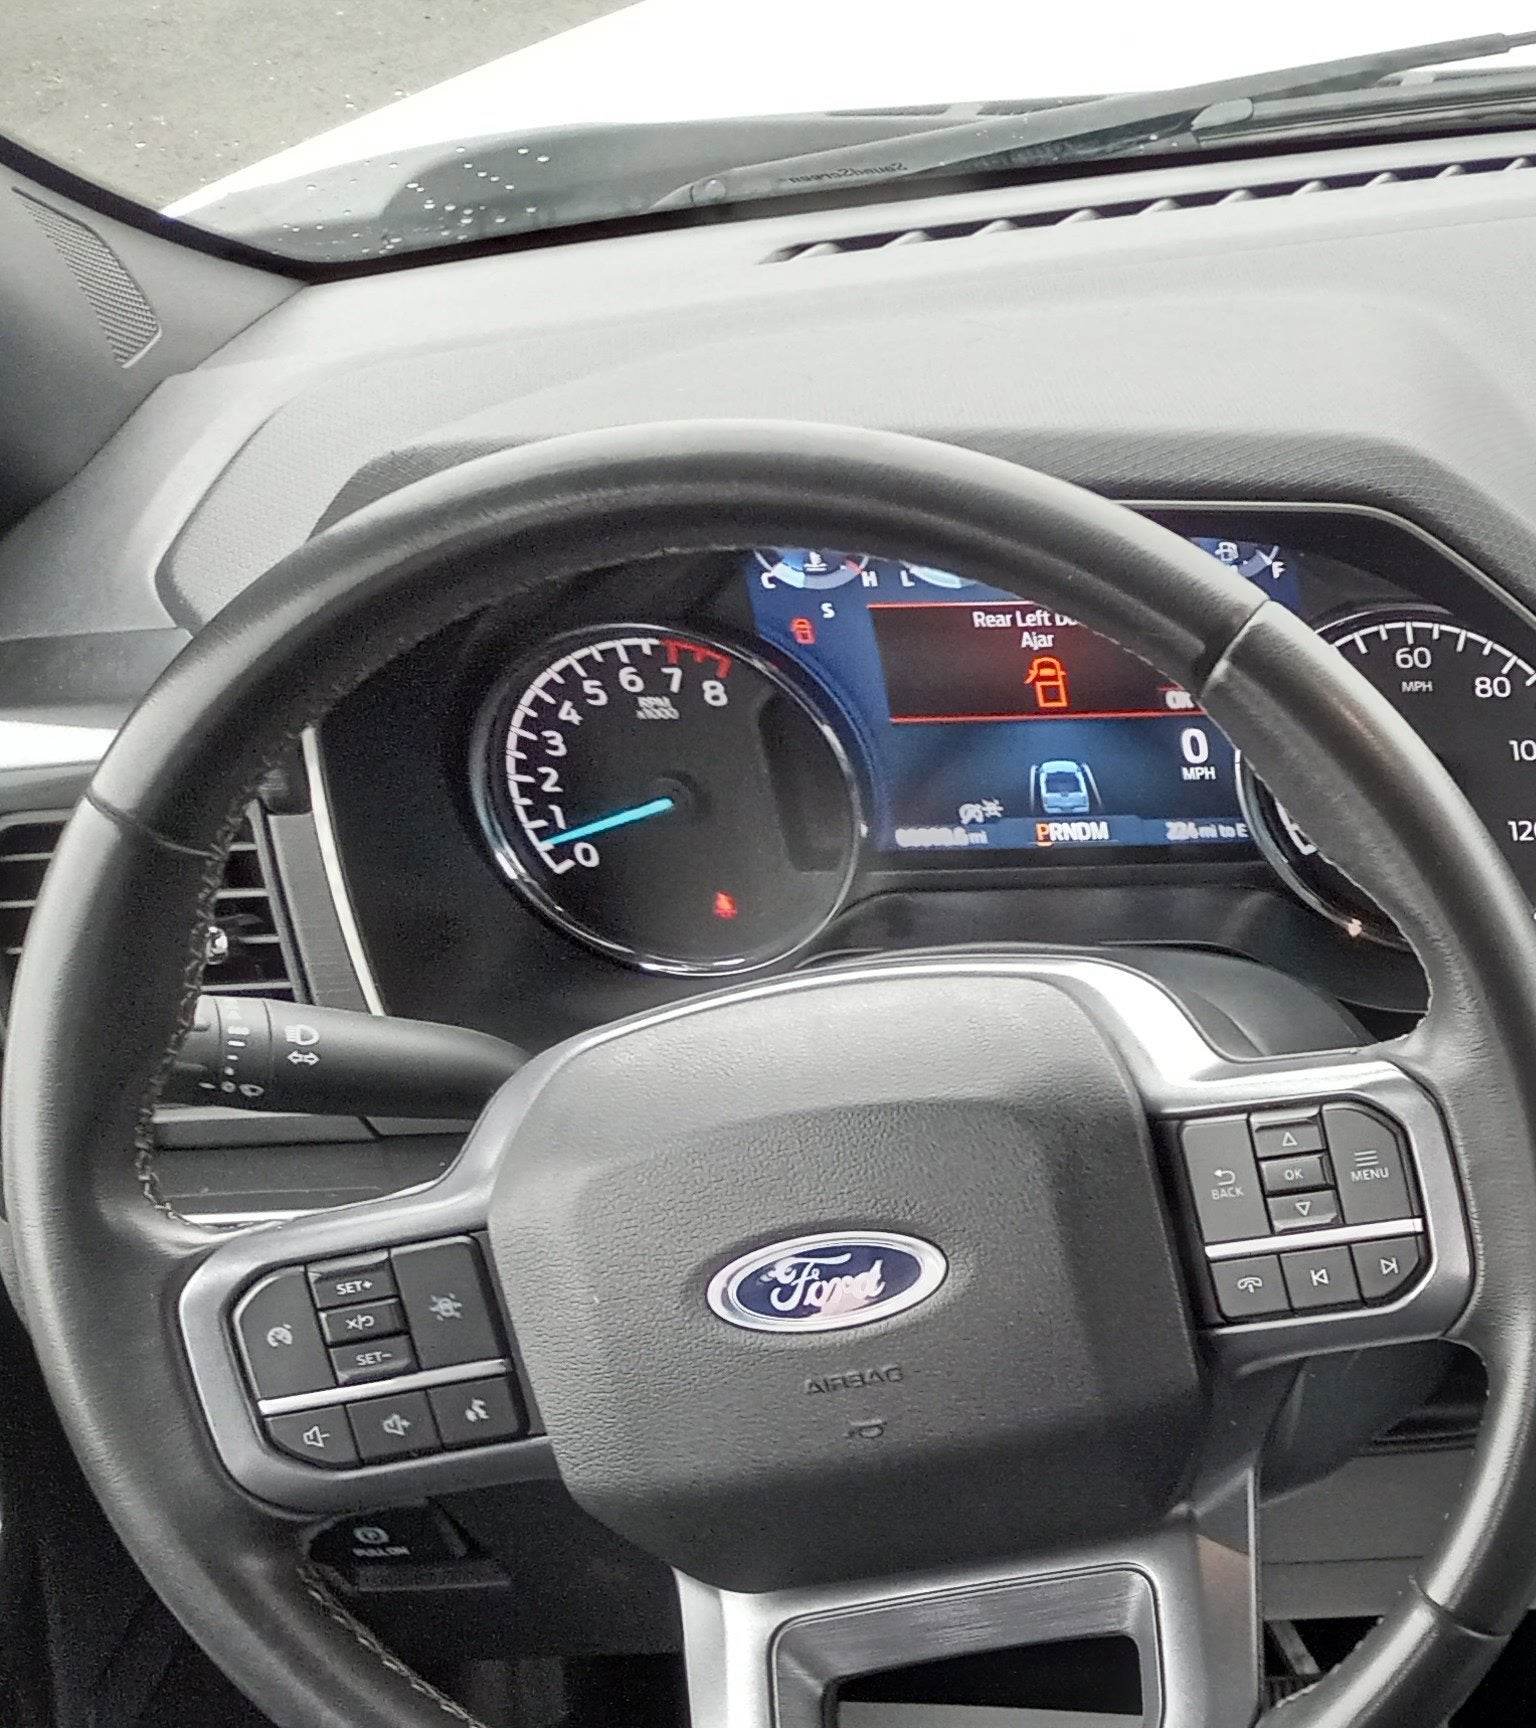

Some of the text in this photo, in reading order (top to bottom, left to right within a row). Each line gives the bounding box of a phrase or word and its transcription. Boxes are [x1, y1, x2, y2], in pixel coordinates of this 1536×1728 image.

[761, 572, 776, 589] C
[862, 571, 878, 587] H
[901, 571, 915, 587] L
[821, 603, 835, 618] S
[972, 611, 1013, 628] Rear
[1015, 610, 1052, 627] Left
[1020, 632, 1054, 650] Ajar
[1395, 648, 1432, 669] 60
[619, 668, 644, 692] 6
[662, 668, 683, 692] 7
[1401, 680, 1433, 693] MPH
[1474, 676, 1511, 699] 80
[583, 681, 607, 706] 5
[703, 681, 727, 706] 8
[558, 702, 582, 726] 4
[545, 733, 567, 757] 3
[1181, 727, 1209, 763] 0
[538, 768, 562, 793] 2
[1181, 766, 1216, 781] MPH
[1220, 824, 1235, 837] to
[575, 843, 599, 868] 0
[1284, 1167, 1304, 1181] OK
[1350, 1167, 1390, 1181] MENU
[1211, 1186, 1245, 1201] BACK
[762, 1254, 887, 1312] Ford
[804, 1365, 904, 1395] AIRBAG
